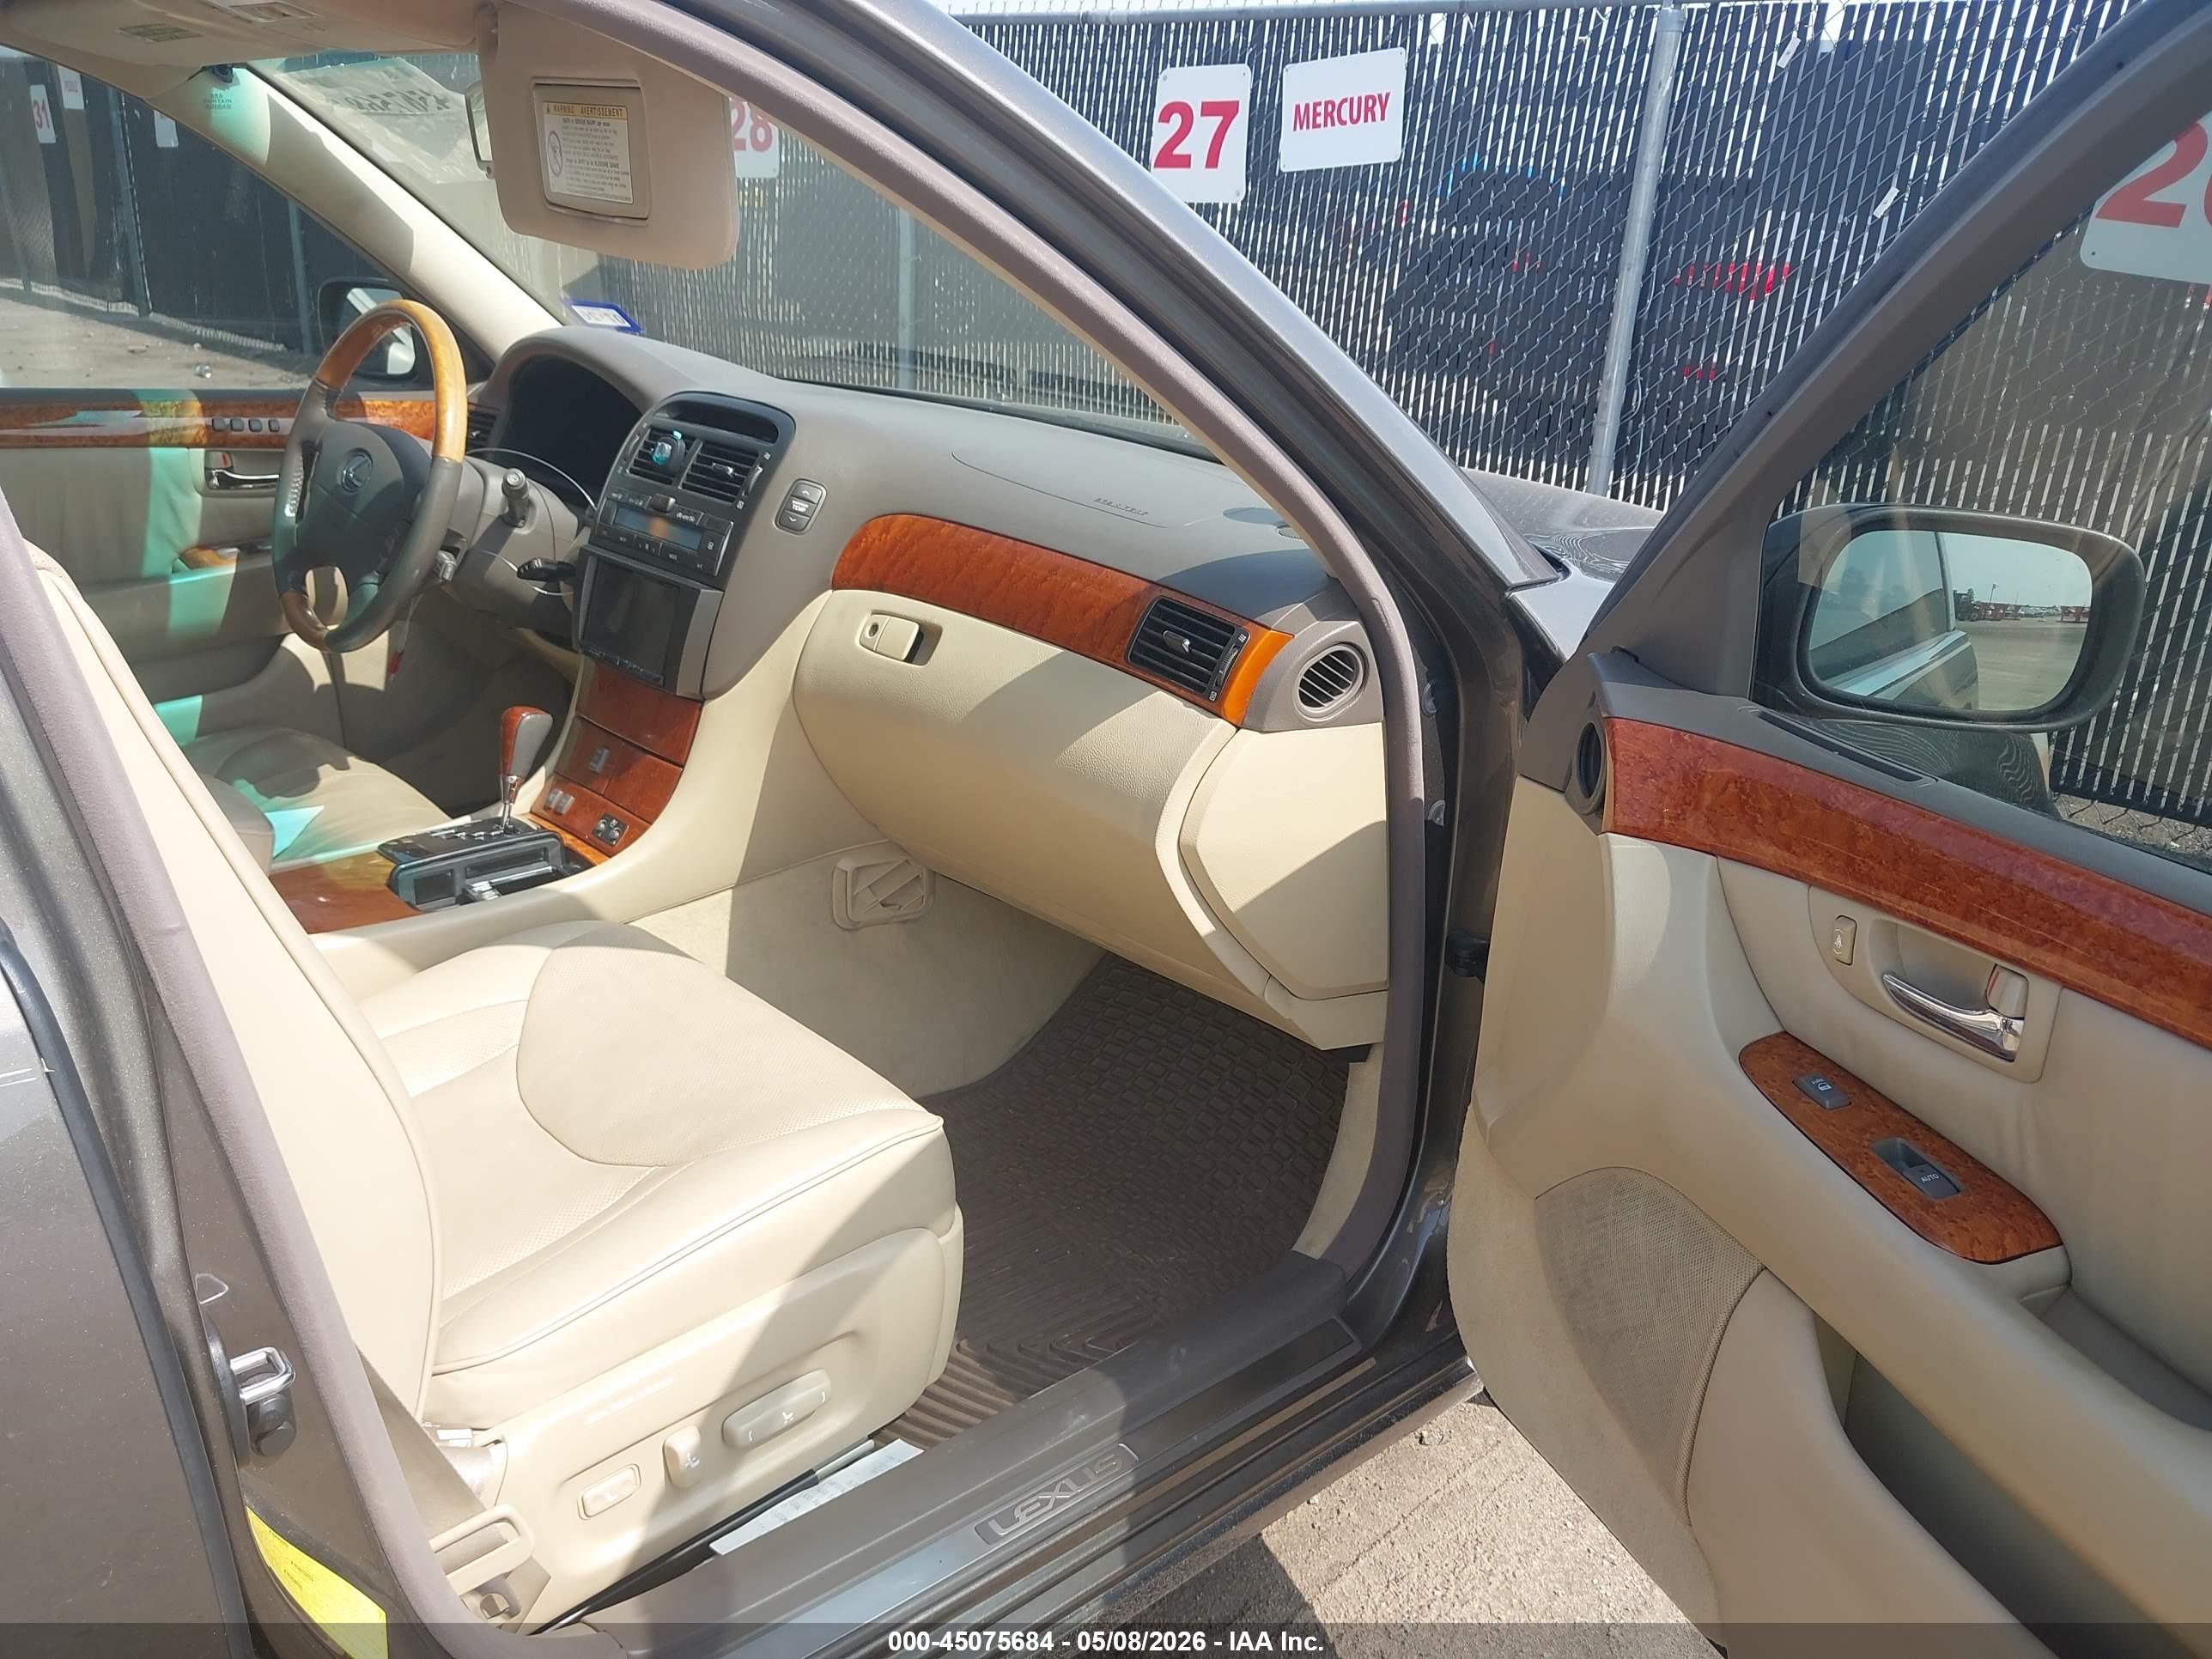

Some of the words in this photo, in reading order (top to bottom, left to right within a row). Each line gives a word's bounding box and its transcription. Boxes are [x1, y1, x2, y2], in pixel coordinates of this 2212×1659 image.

[1153, 100, 1239, 169] 27
[1292, 92, 1391, 131] MERCURY
[2095, 123, 2212, 230] 2
[1920, 1173, 1940, 1183] AUTO
[988, 1454, 1123, 1536] LEXUS
